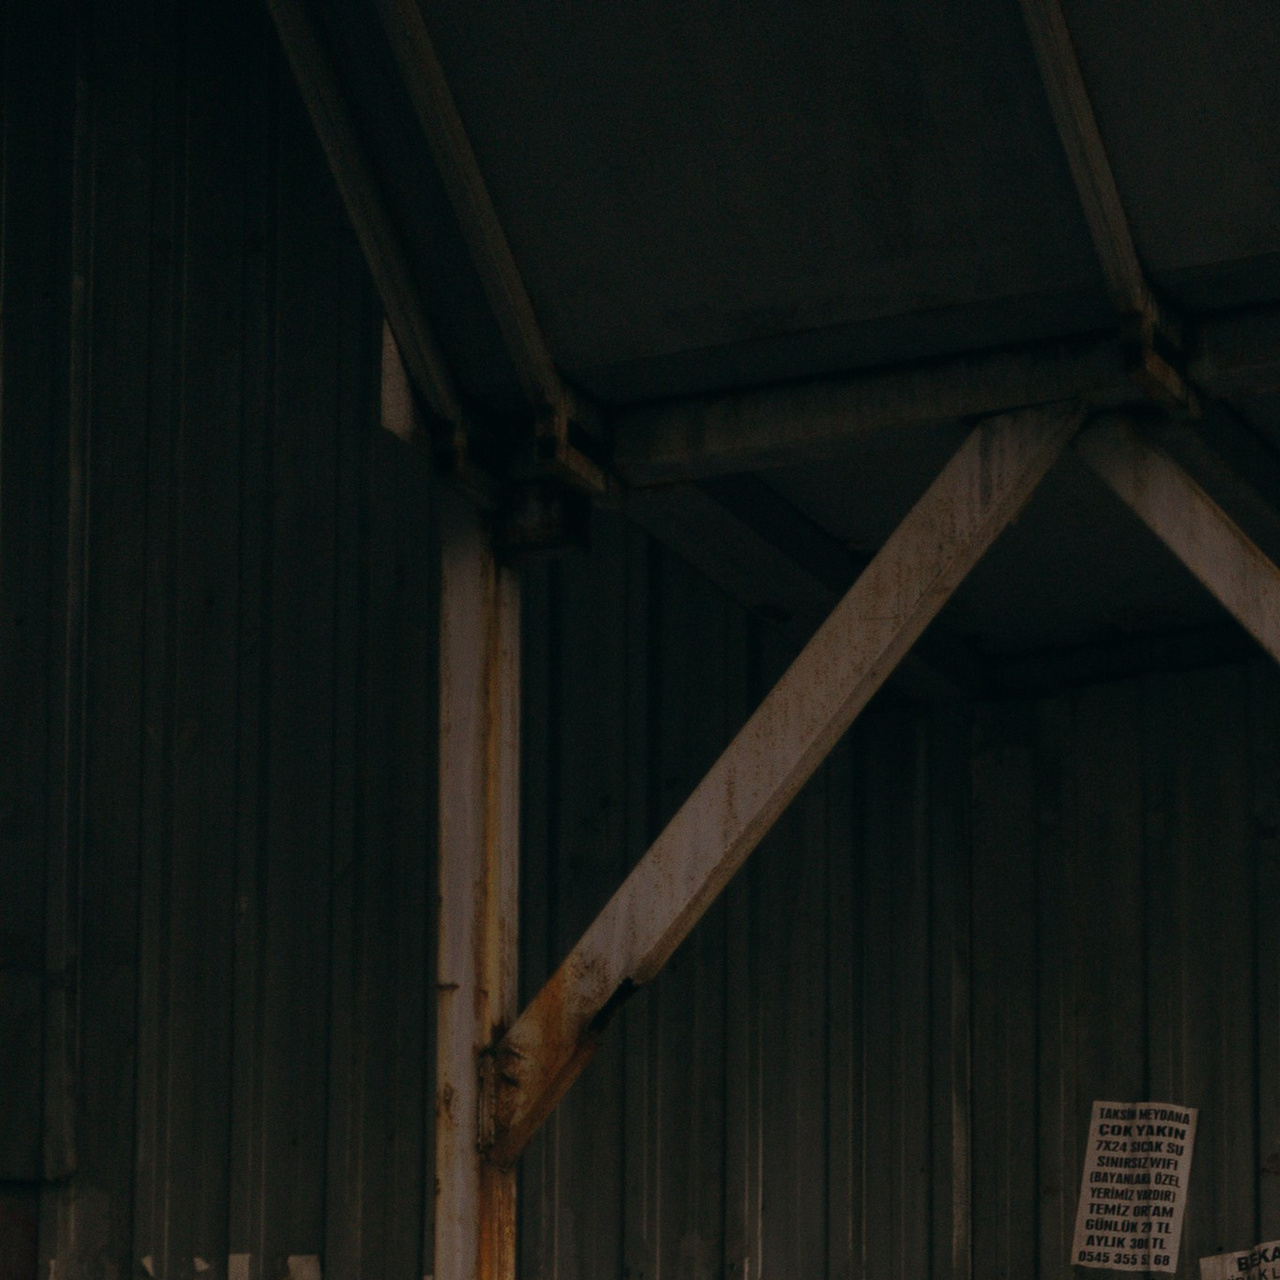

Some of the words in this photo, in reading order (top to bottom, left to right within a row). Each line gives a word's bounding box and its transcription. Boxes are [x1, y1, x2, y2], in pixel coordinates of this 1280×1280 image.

[1136, 1125, 1185, 1140] YAKIN
[1167, 1143, 1184, 1156] SU
[1089, 1203, 1130, 1216] TEMİZ
[1158, 1222, 1172, 1234] TL
[1086, 1235, 1126, 1248] AYLIK
[1152, 1238, 1166, 1250] TL
[1079, 1251, 1110, 1263] 0545
[1114, 1253, 1137, 1265] 355
[1154, 1255, 1170, 1265] 68
